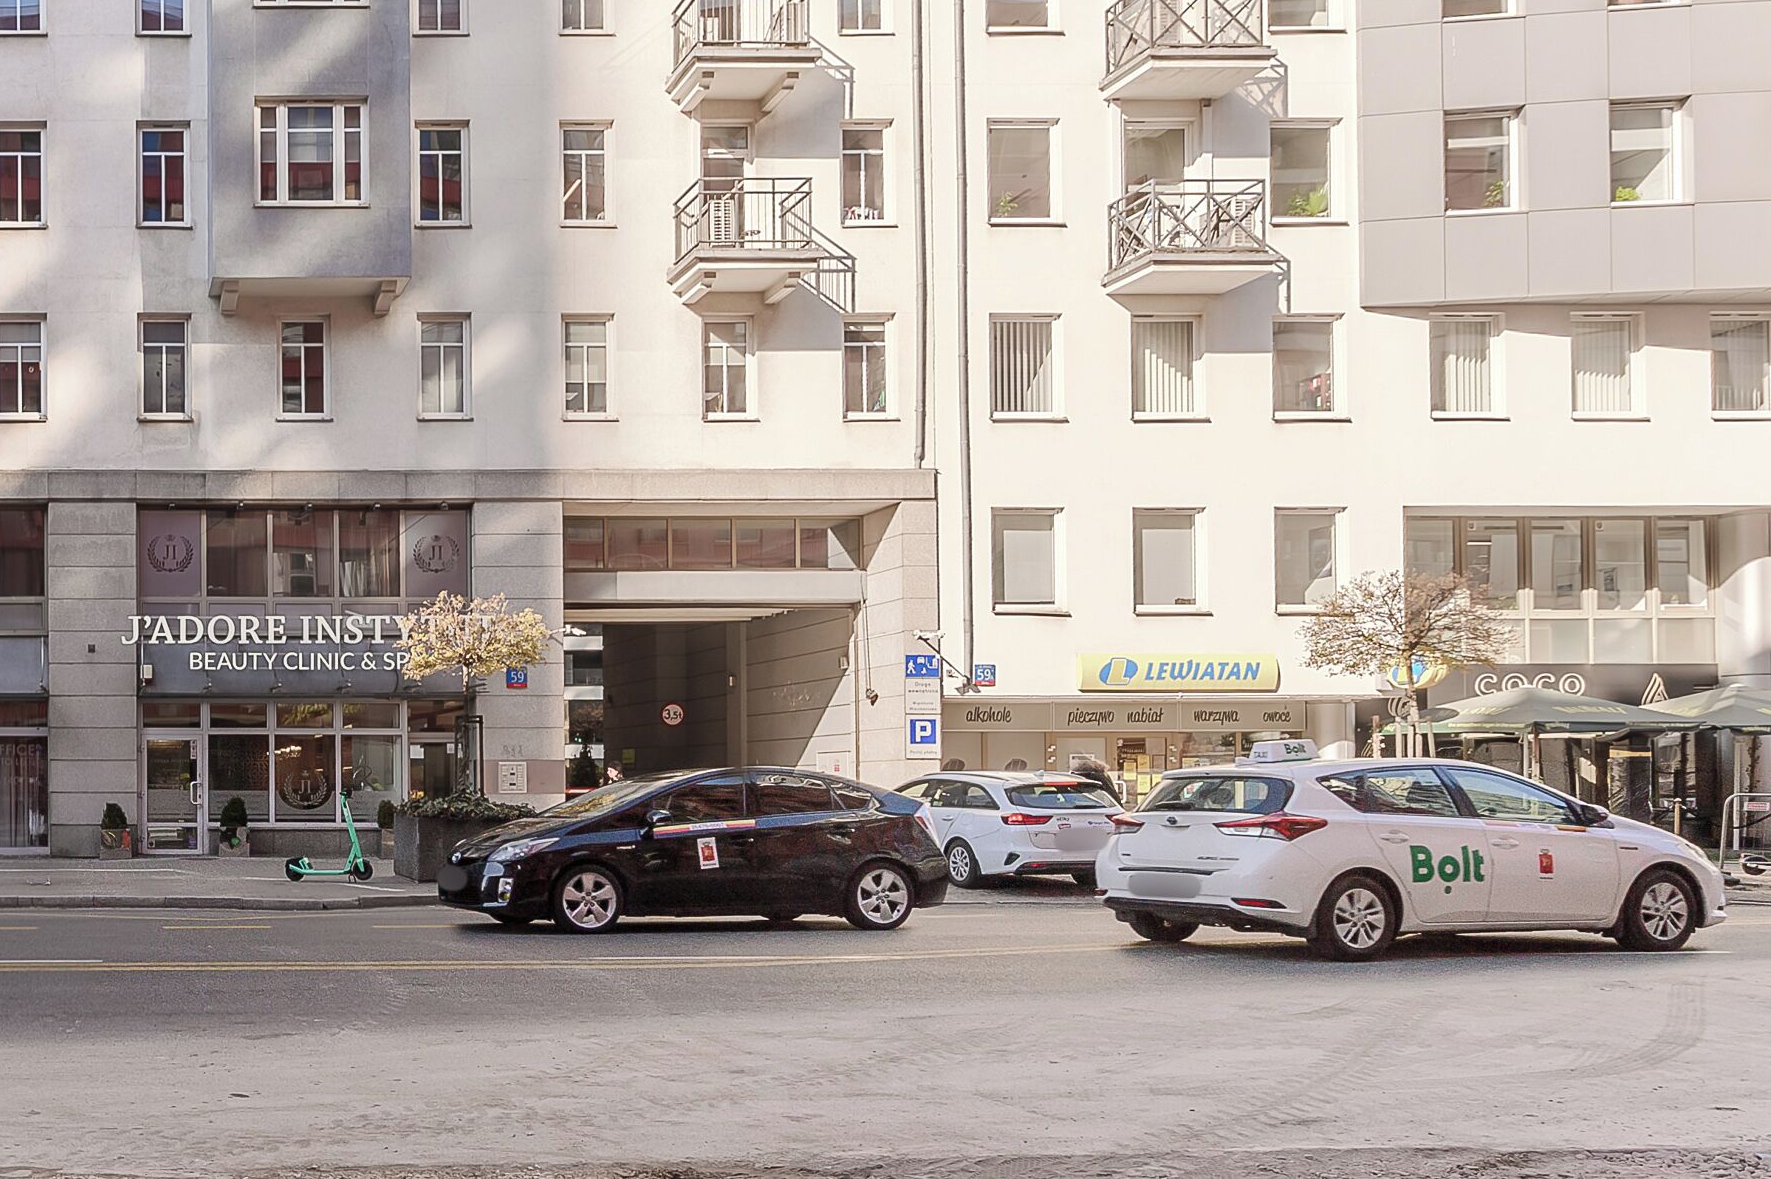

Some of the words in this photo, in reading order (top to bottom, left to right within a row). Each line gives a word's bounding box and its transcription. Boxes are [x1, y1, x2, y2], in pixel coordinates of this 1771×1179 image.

[189, 652, 278, 671] BEAUTY
[282, 652, 355, 671] CLINIC
[361, 652, 376, 671] &
[383, 652, 417, 671] SP
[1143, 659, 1260, 682] LEWIATAN
[511, 670, 525, 683] 59
[1475, 672, 1585, 697] COCO
[663, 708, 683, 721] 3,5t
[966, 706, 1012, 723] alkohole
[1067, 707, 1115, 727] pieczywo
[1127, 706, 1165, 723] nabiał
[1193, 708, 1239, 727] warzywa
[915, 721, 932, 742] P
[1284, 742, 1307, 757] Bolt
[1409, 845, 1486, 894] Bolt
